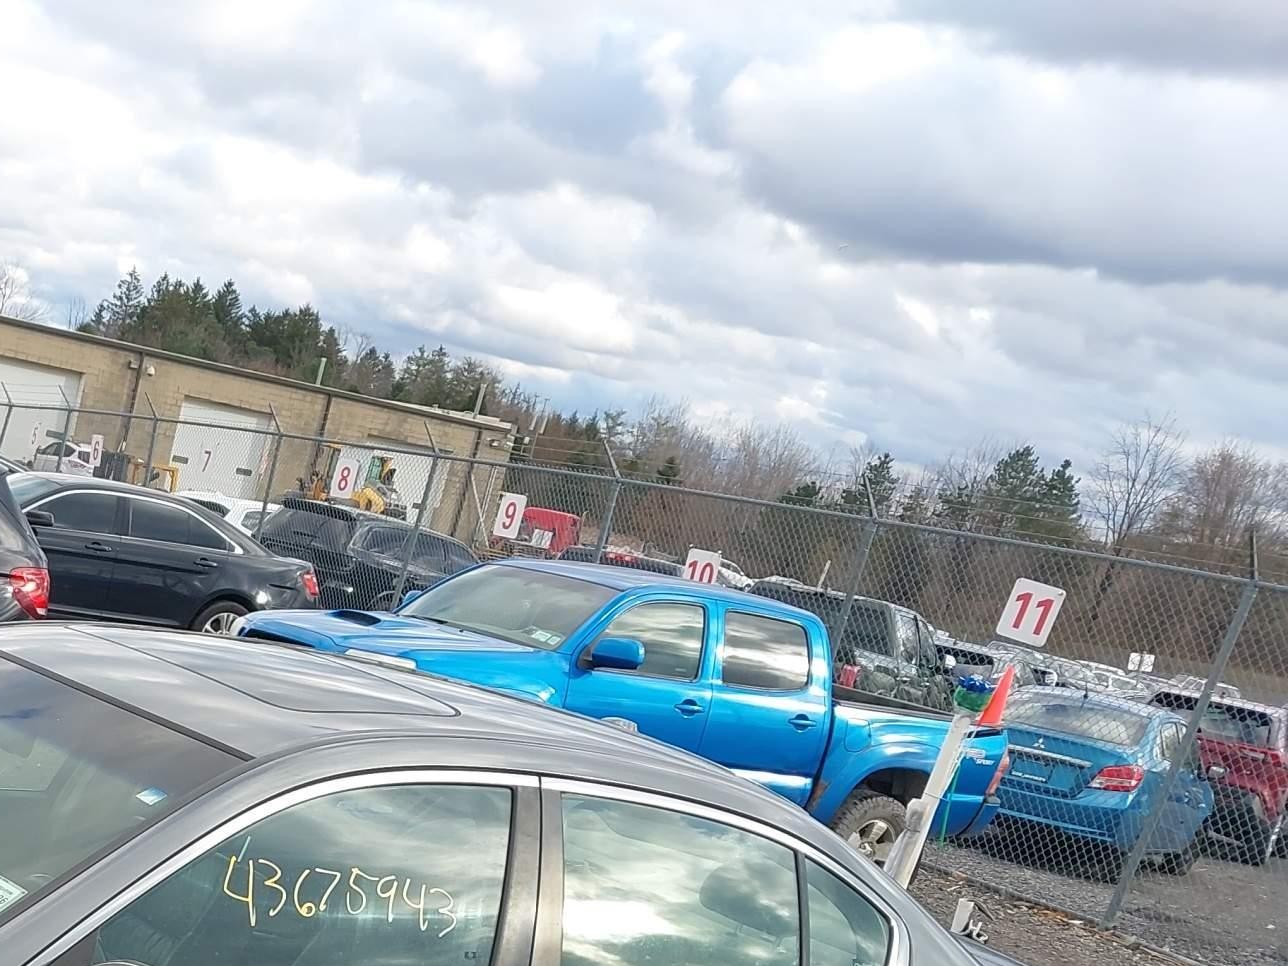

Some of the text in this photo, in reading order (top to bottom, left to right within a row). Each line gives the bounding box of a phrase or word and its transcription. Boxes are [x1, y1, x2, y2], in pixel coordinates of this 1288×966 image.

[92, 440, 100, 461] 6
[202, 451, 212, 473] 7
[337, 466, 351, 492] 8
[502, 501, 518, 531] 9
[688, 559, 714, 585] 10
[1013, 591, 1055, 636] 11
[223, 855, 457, 938] 43675943
